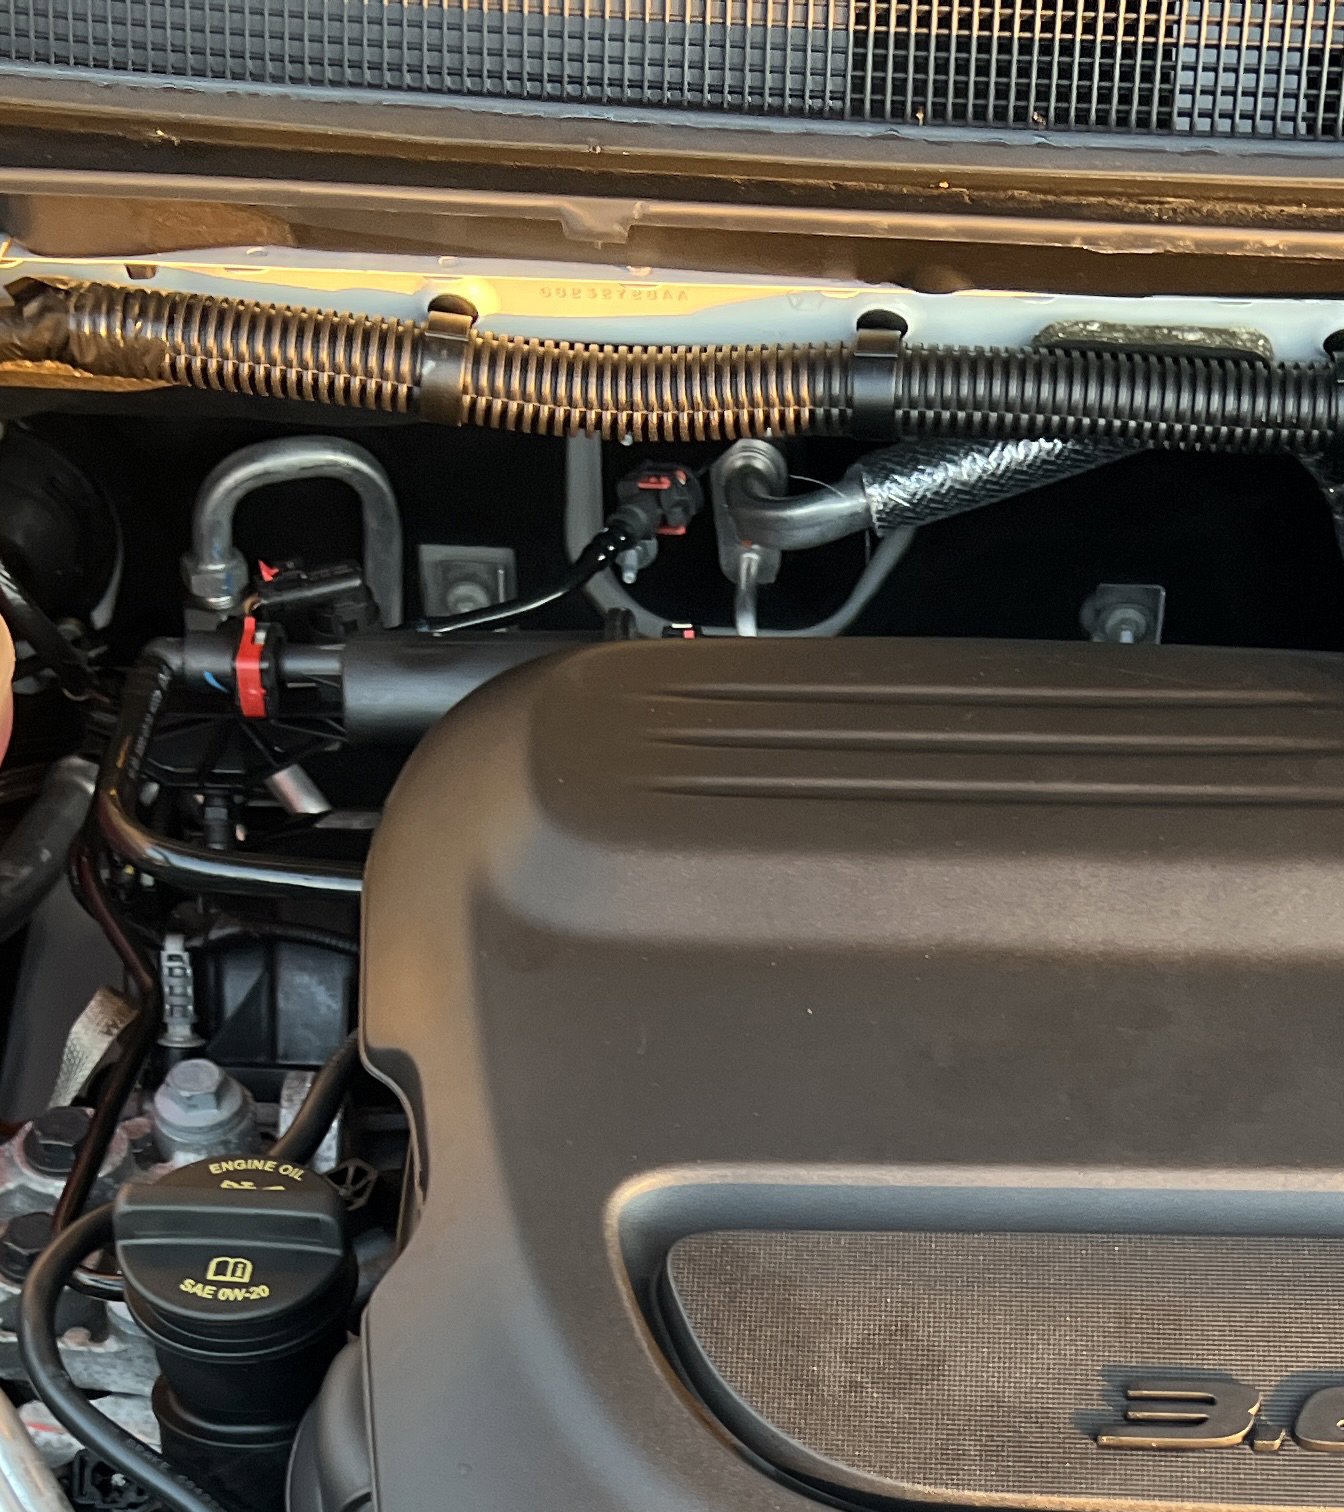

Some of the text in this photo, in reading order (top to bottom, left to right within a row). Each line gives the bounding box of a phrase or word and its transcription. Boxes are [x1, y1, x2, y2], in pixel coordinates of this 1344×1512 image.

[209, 1160, 304, 1181] ENGINE OIL
[180, 1279, 269, 1301] SAE 0W-20
